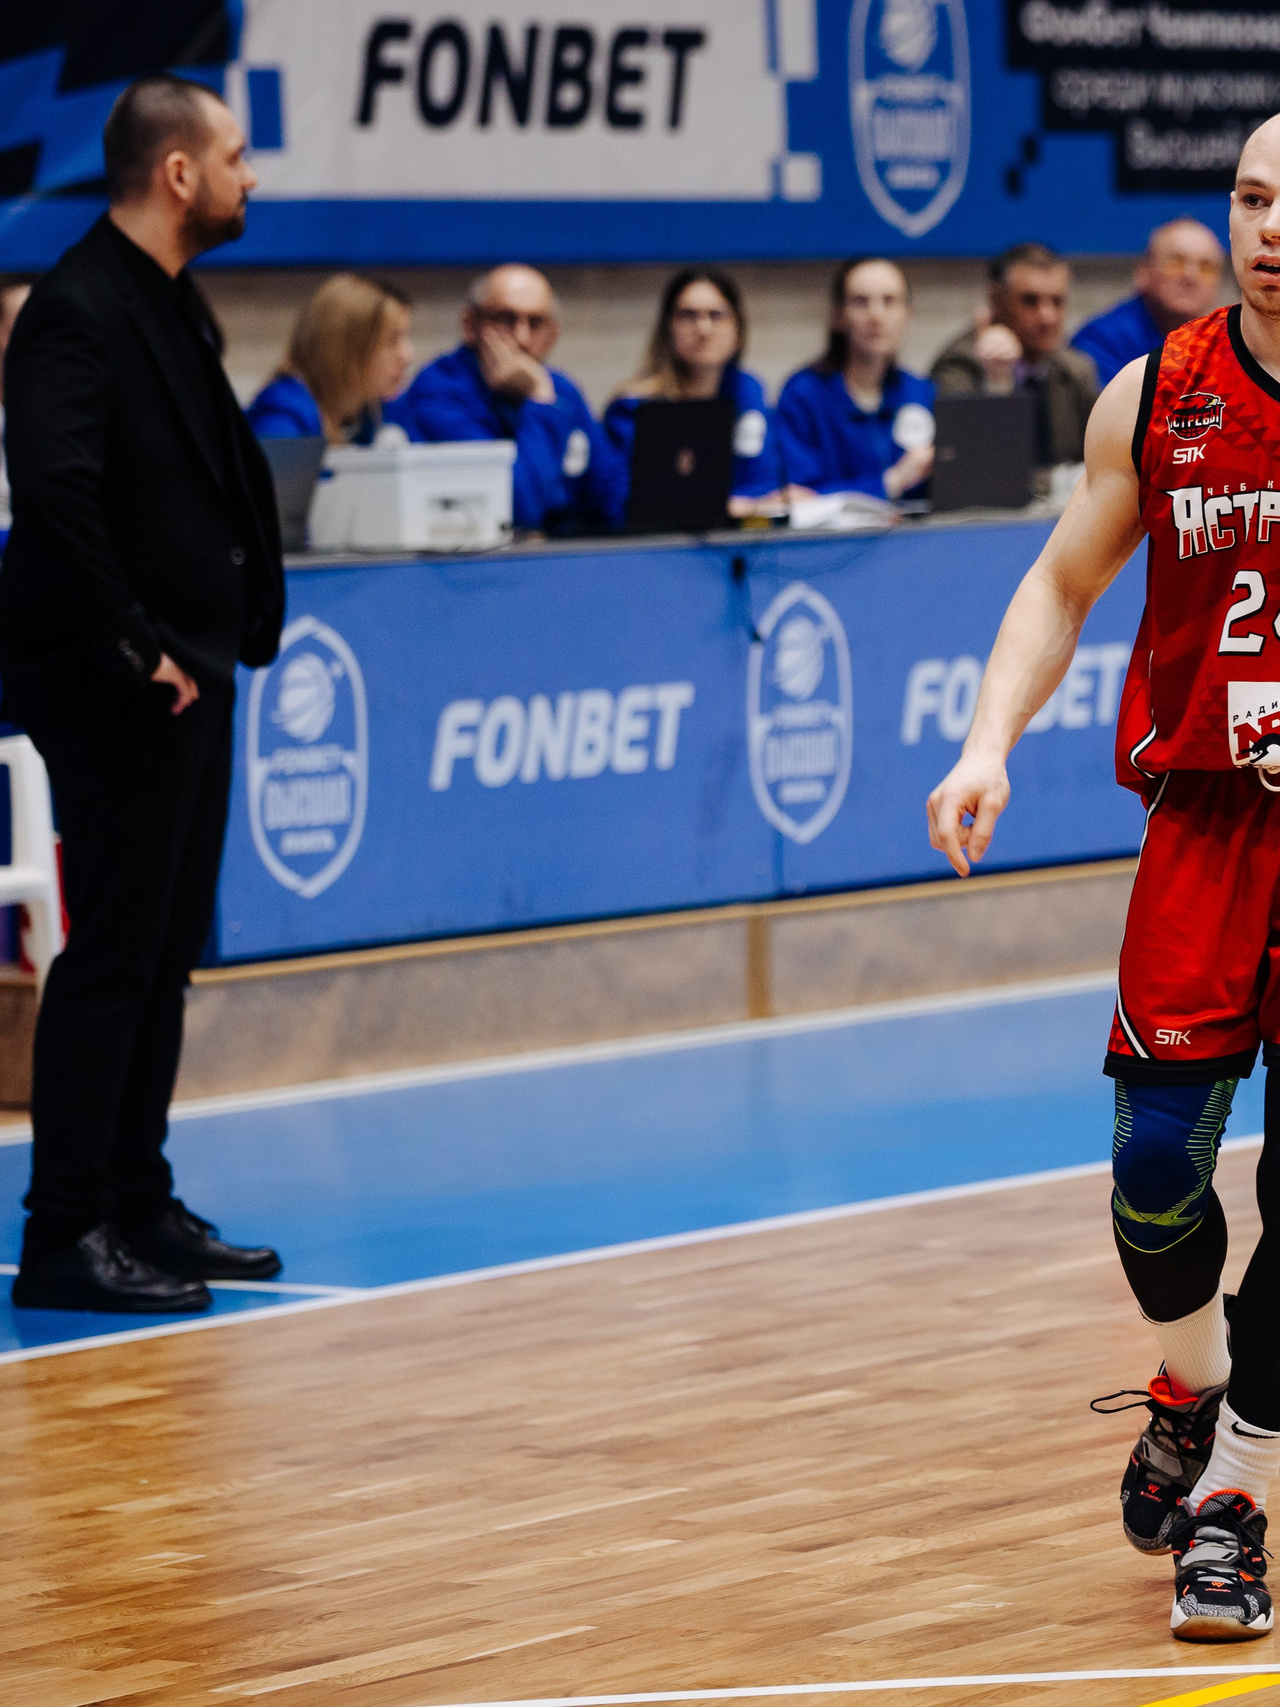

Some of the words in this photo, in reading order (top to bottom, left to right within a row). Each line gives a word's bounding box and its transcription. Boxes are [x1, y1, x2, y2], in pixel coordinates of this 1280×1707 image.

[354, 19, 707, 131] FONBET
[1172, 443, 1207, 465] STK
[428, 681, 696, 791] FONBET
[901, 641, 1131, 746] FOET
[1154, 1028, 1192, 1046] STK
